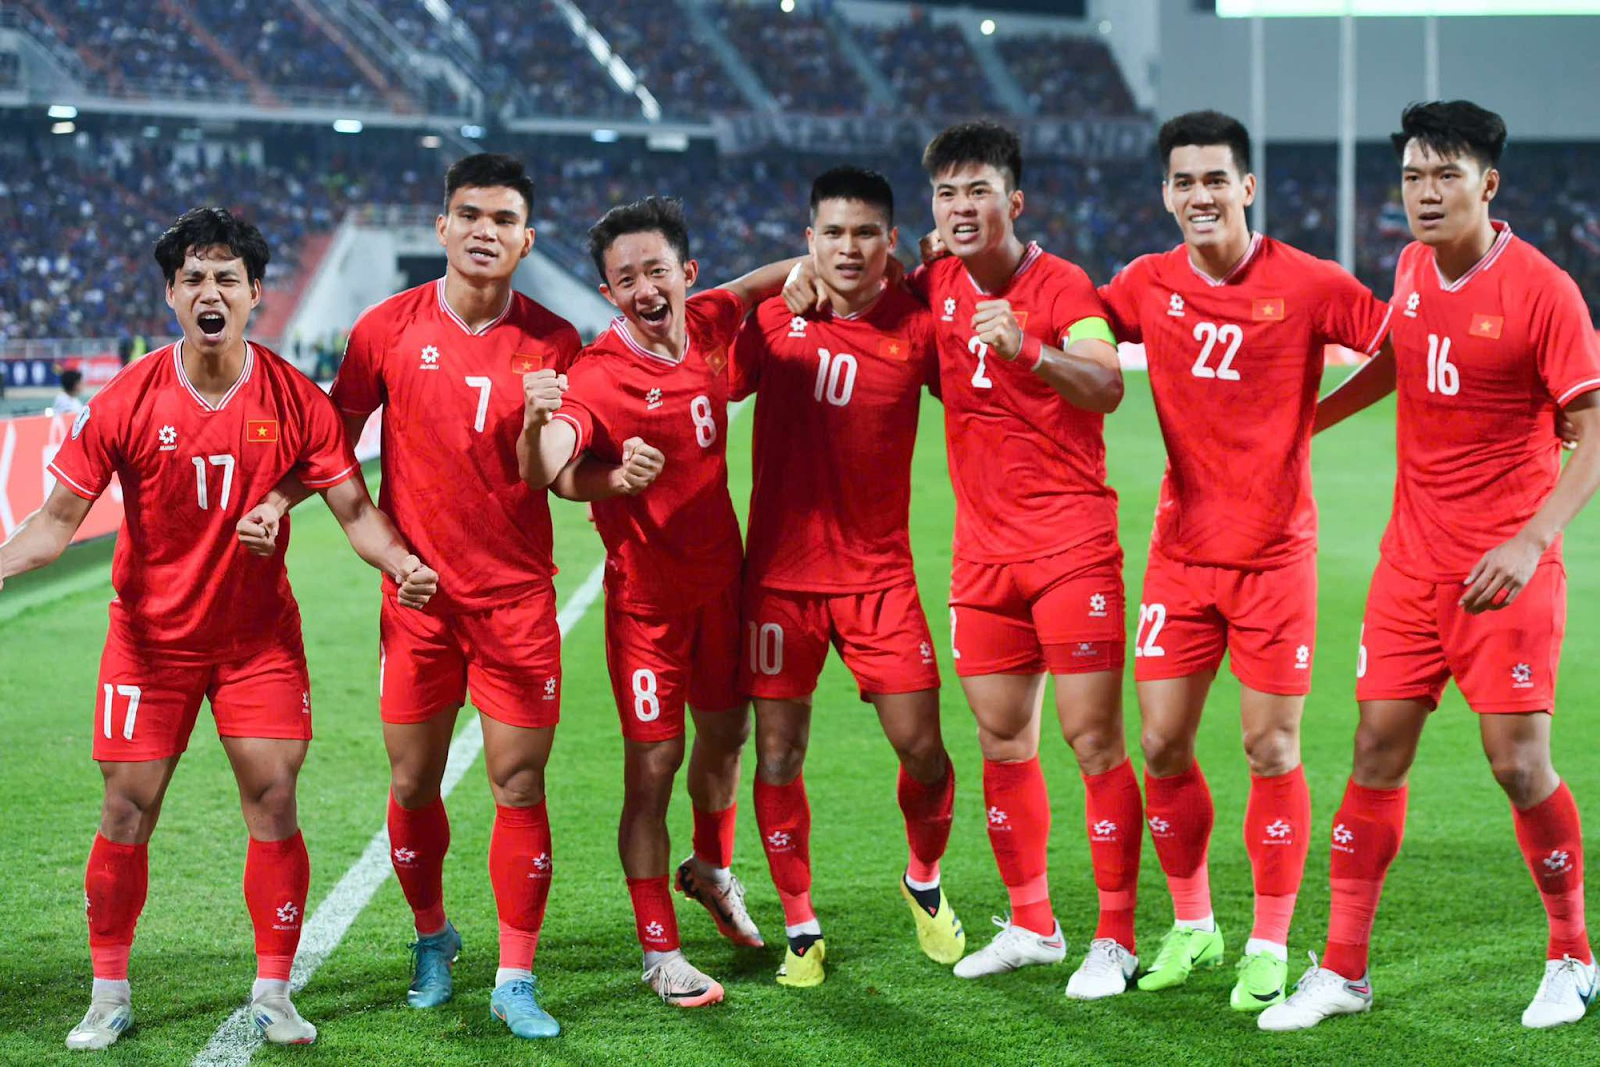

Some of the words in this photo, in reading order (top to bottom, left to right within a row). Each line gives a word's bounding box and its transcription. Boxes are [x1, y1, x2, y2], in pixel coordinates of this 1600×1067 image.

[814, 347, 858, 407] 10
[967, 335, 993, 389] 2
[1191, 321, 1244, 381] 22
[1426, 333, 1460, 396] 16
[464, 375, 493, 433] 7
[690, 395, 717, 448] 8
[191, 454, 235, 511] 17
[748, 620, 784, 676] 10
[103, 683, 142, 740] 17
[631, 668, 661, 723] 8
